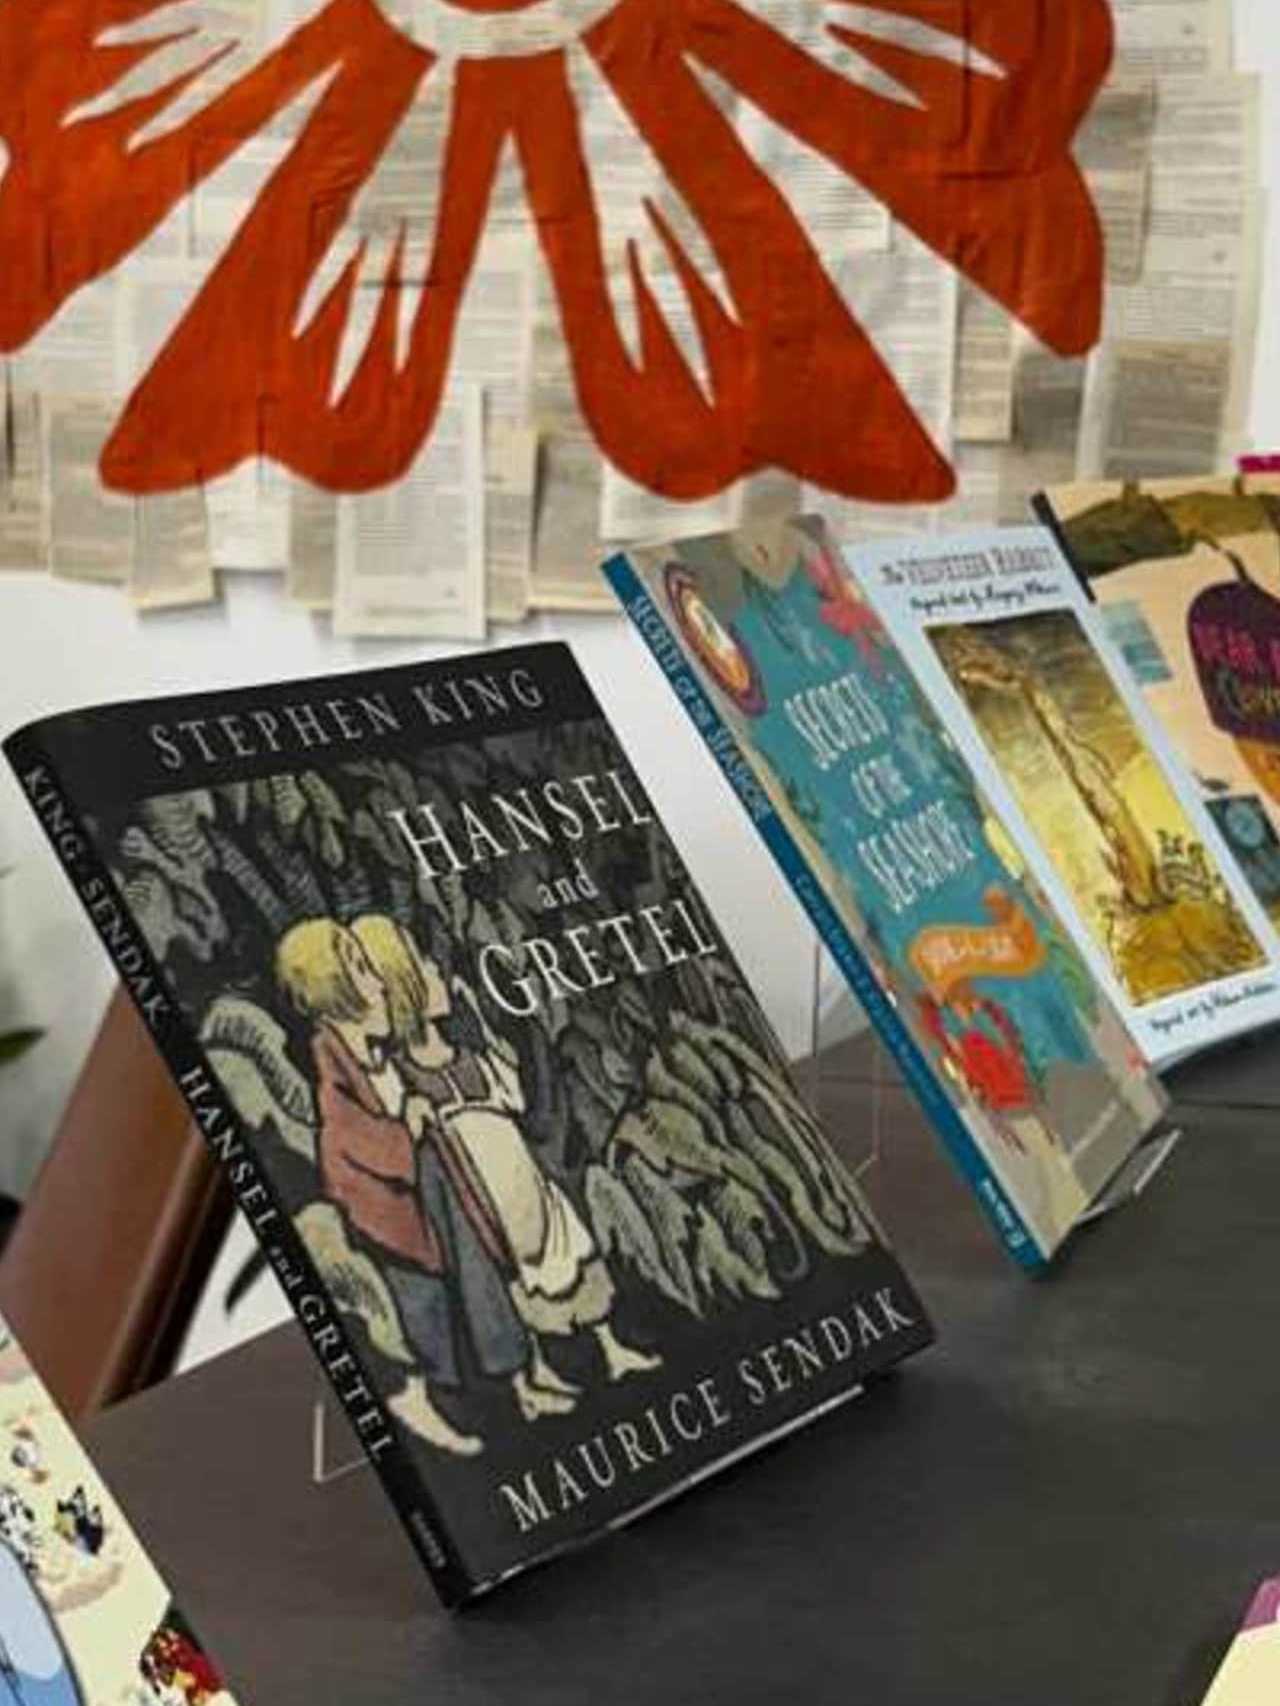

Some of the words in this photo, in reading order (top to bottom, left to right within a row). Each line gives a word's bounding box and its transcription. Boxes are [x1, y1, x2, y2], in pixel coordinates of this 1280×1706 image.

[150, 692, 400, 772] STEPHEN
[416, 669, 544, 728] KING
[783, 673, 889, 770] SECRETS
[389, 769, 653, 881] HANSEL
[856, 799, 975, 914] SEASHORE
[536, 870, 601, 910] and
[477, 899, 720, 1019] GRETEL
[23, 764, 80, 863] KING
[82, 875, 167, 1032] SENDAK
[179, 1065, 281, 1251] HANSEL
[270, 1244, 303, 1294] and
[299, 1293, 400, 1464] GRETEL
[500, 1378, 731, 1532] MAURICE
[738, 1287, 914, 1406] SENDAK
